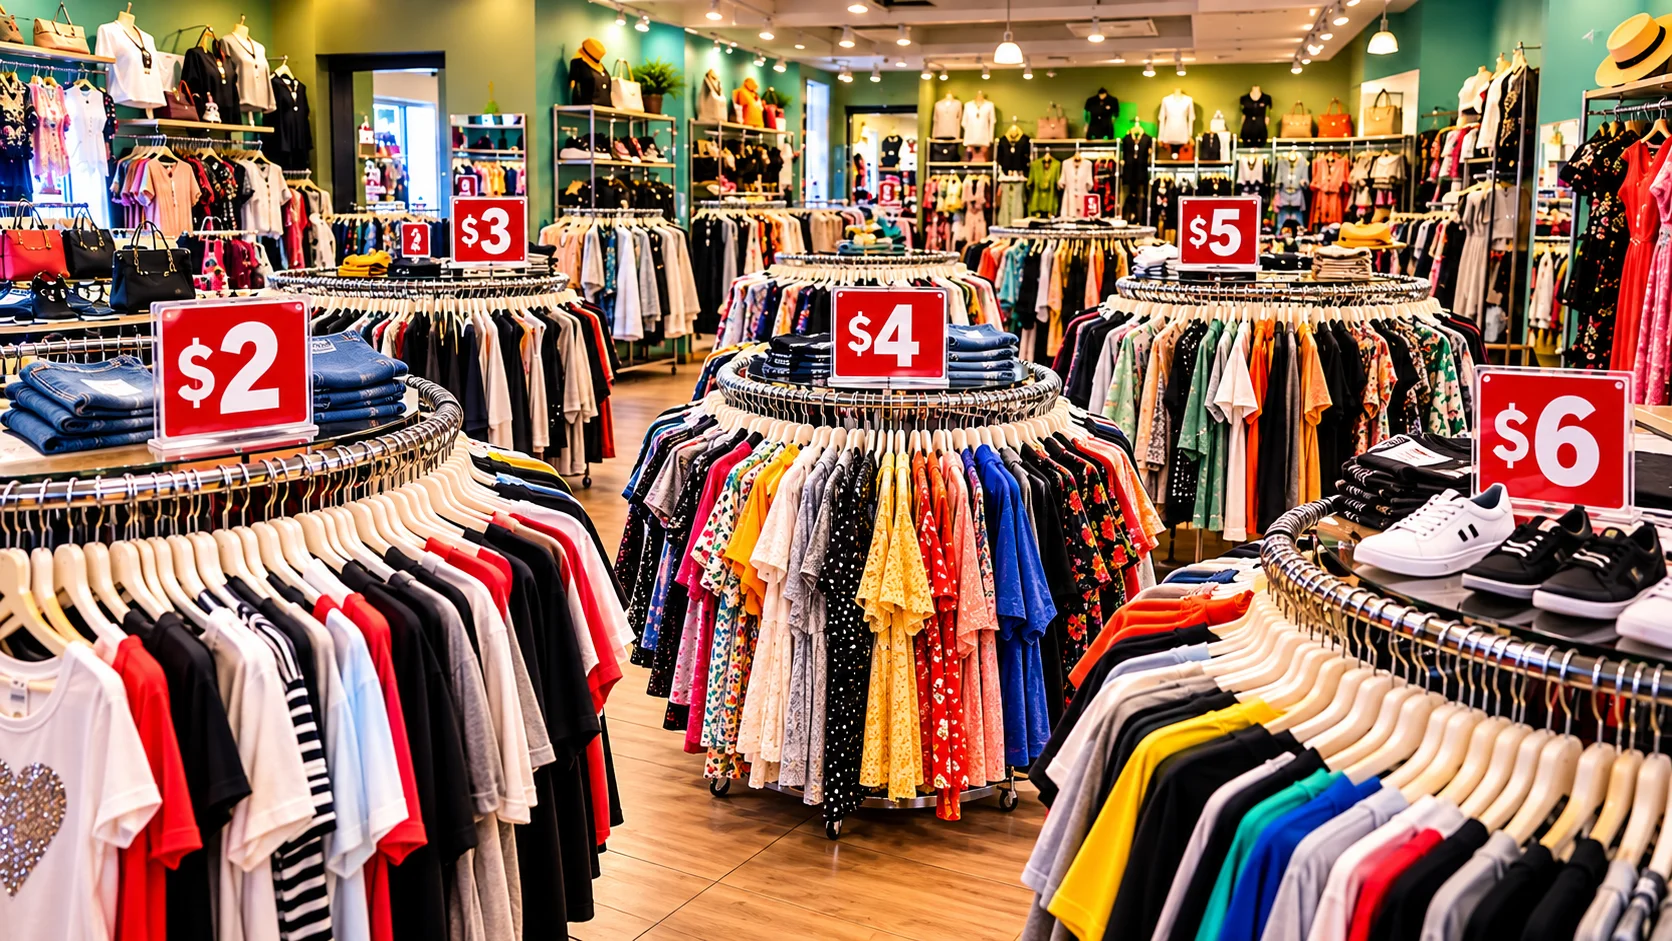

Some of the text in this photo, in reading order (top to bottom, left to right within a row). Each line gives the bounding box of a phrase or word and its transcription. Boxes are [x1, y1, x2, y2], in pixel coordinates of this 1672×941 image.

[461, 207, 512, 255] $3
[1189, 208, 1242, 257] $5
[177, 320, 280, 415] $2
[847, 303, 920, 368] $4
[1492, 395, 1600, 487] $6
